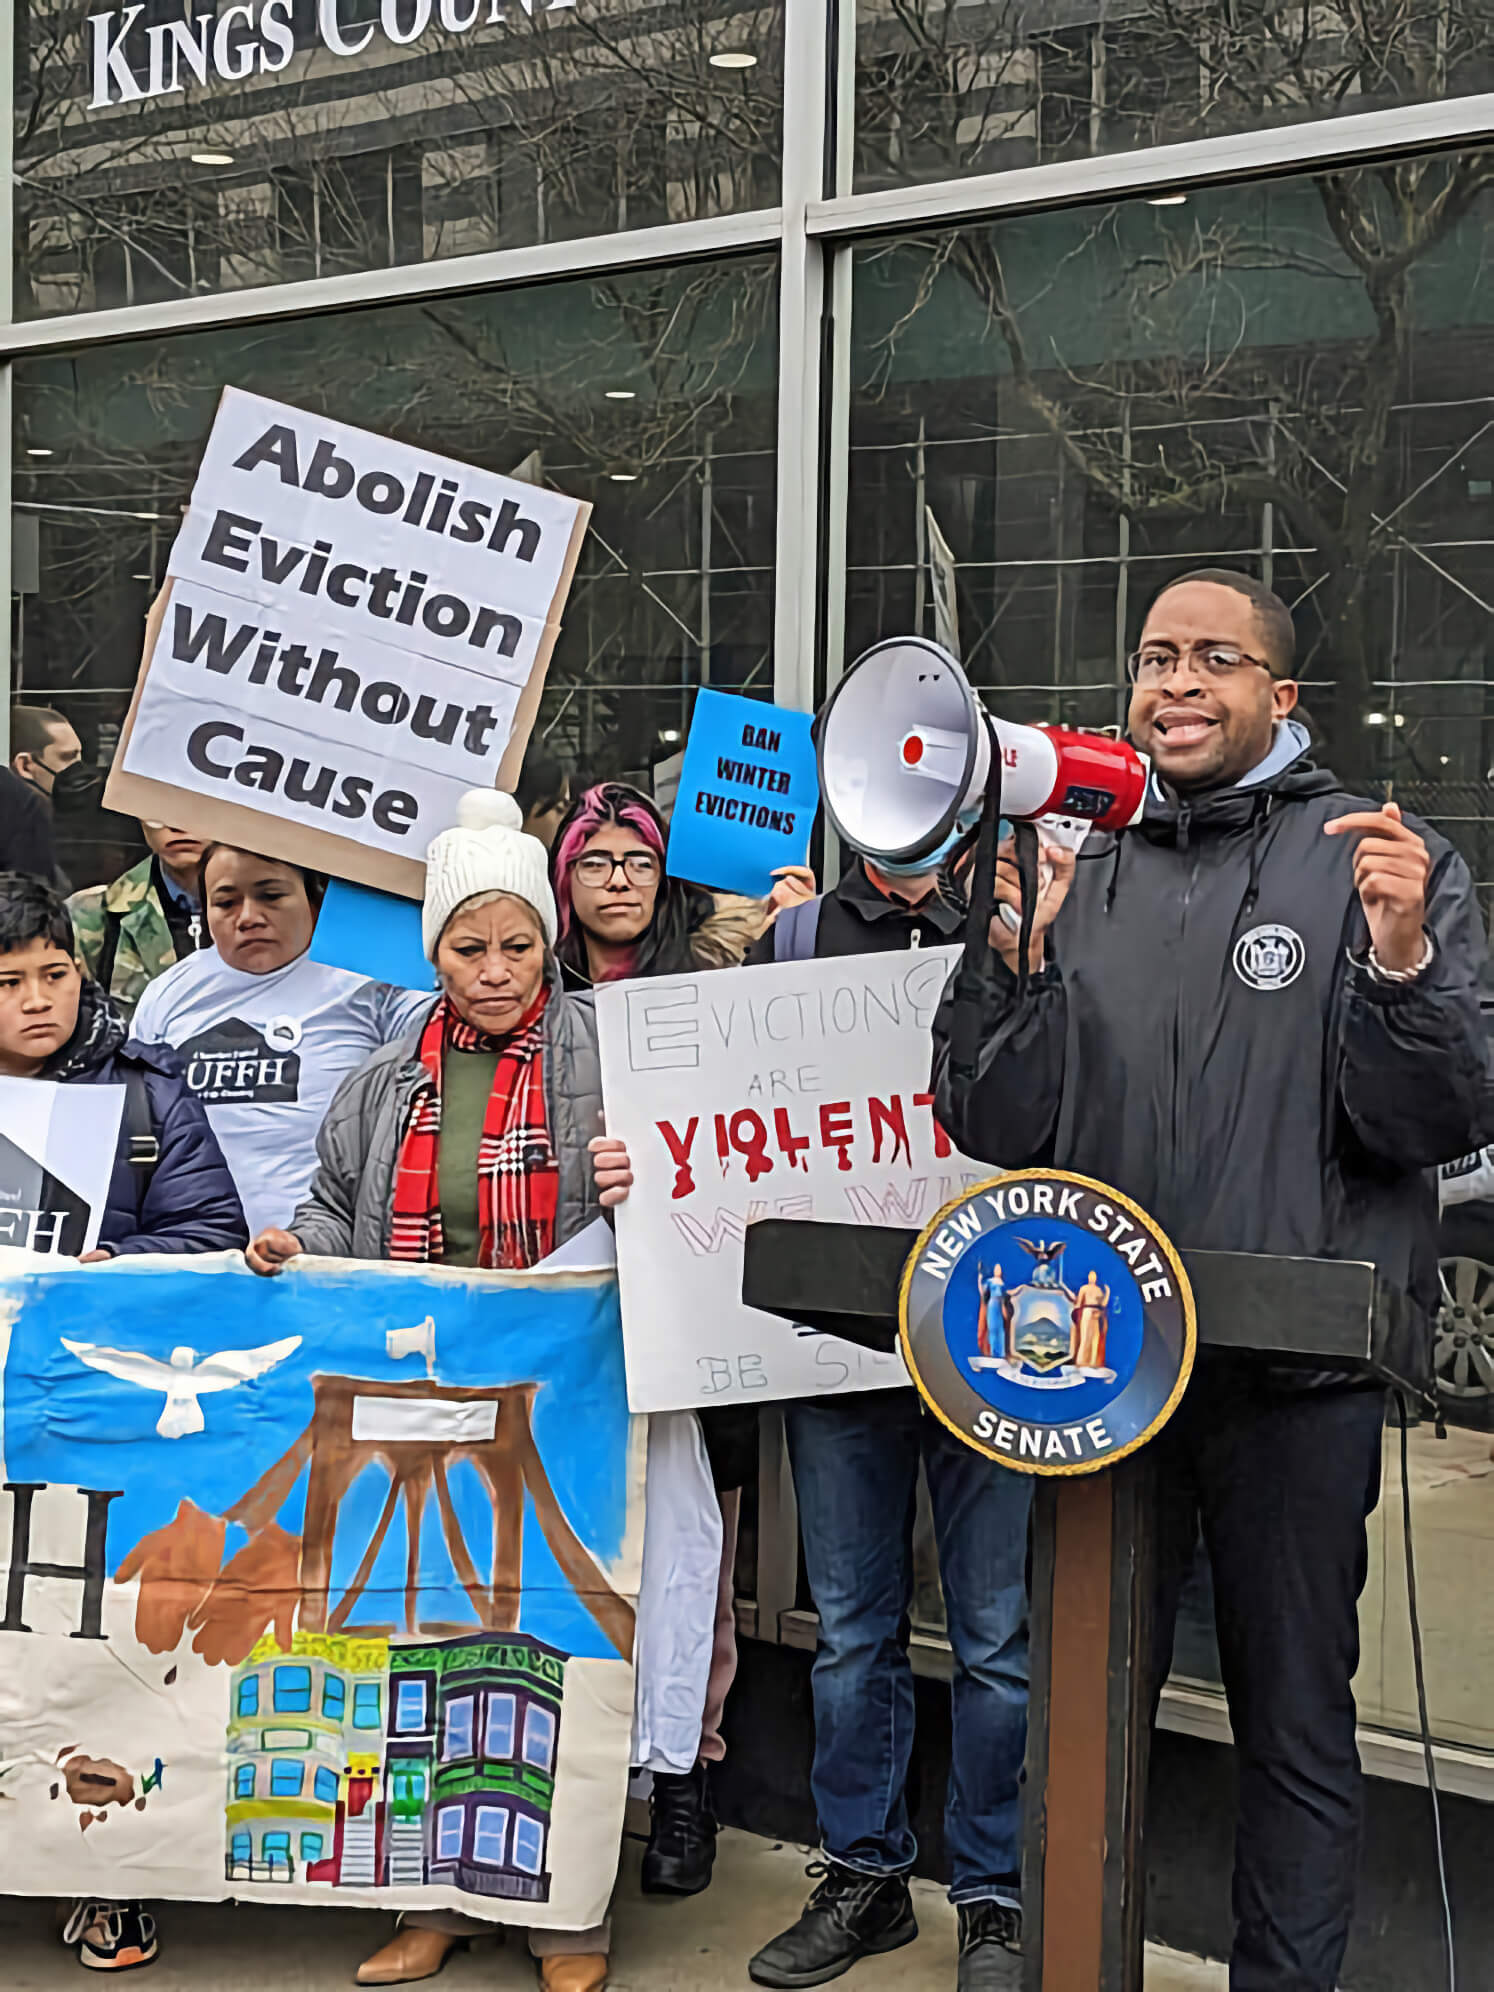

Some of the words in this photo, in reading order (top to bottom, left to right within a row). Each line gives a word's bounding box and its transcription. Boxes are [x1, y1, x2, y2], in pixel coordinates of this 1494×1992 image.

[87, 0, 294, 109] KINGS
[233, 424, 542, 562] Abolish
[201, 509, 523, 658] Eviction
[171, 603, 499, 756] Without
[741, 724, 781, 752] BAN
[187, 721, 418, 835] Cause
[717, 757, 792, 795] WINTER
[695, 791, 796, 835] EVICTIONS
[187, 1058, 289, 1090] UFFH
[747, 1065, 824, 1097] ARE
[921, 1203, 983, 1280] NEW
[985, 1184, 1085, 1221] YORK
[1088, 1203, 1172, 1304] STATE
[696, 1355, 769, 1394] BE
[973, 1410, 1113, 1459] SENATE
